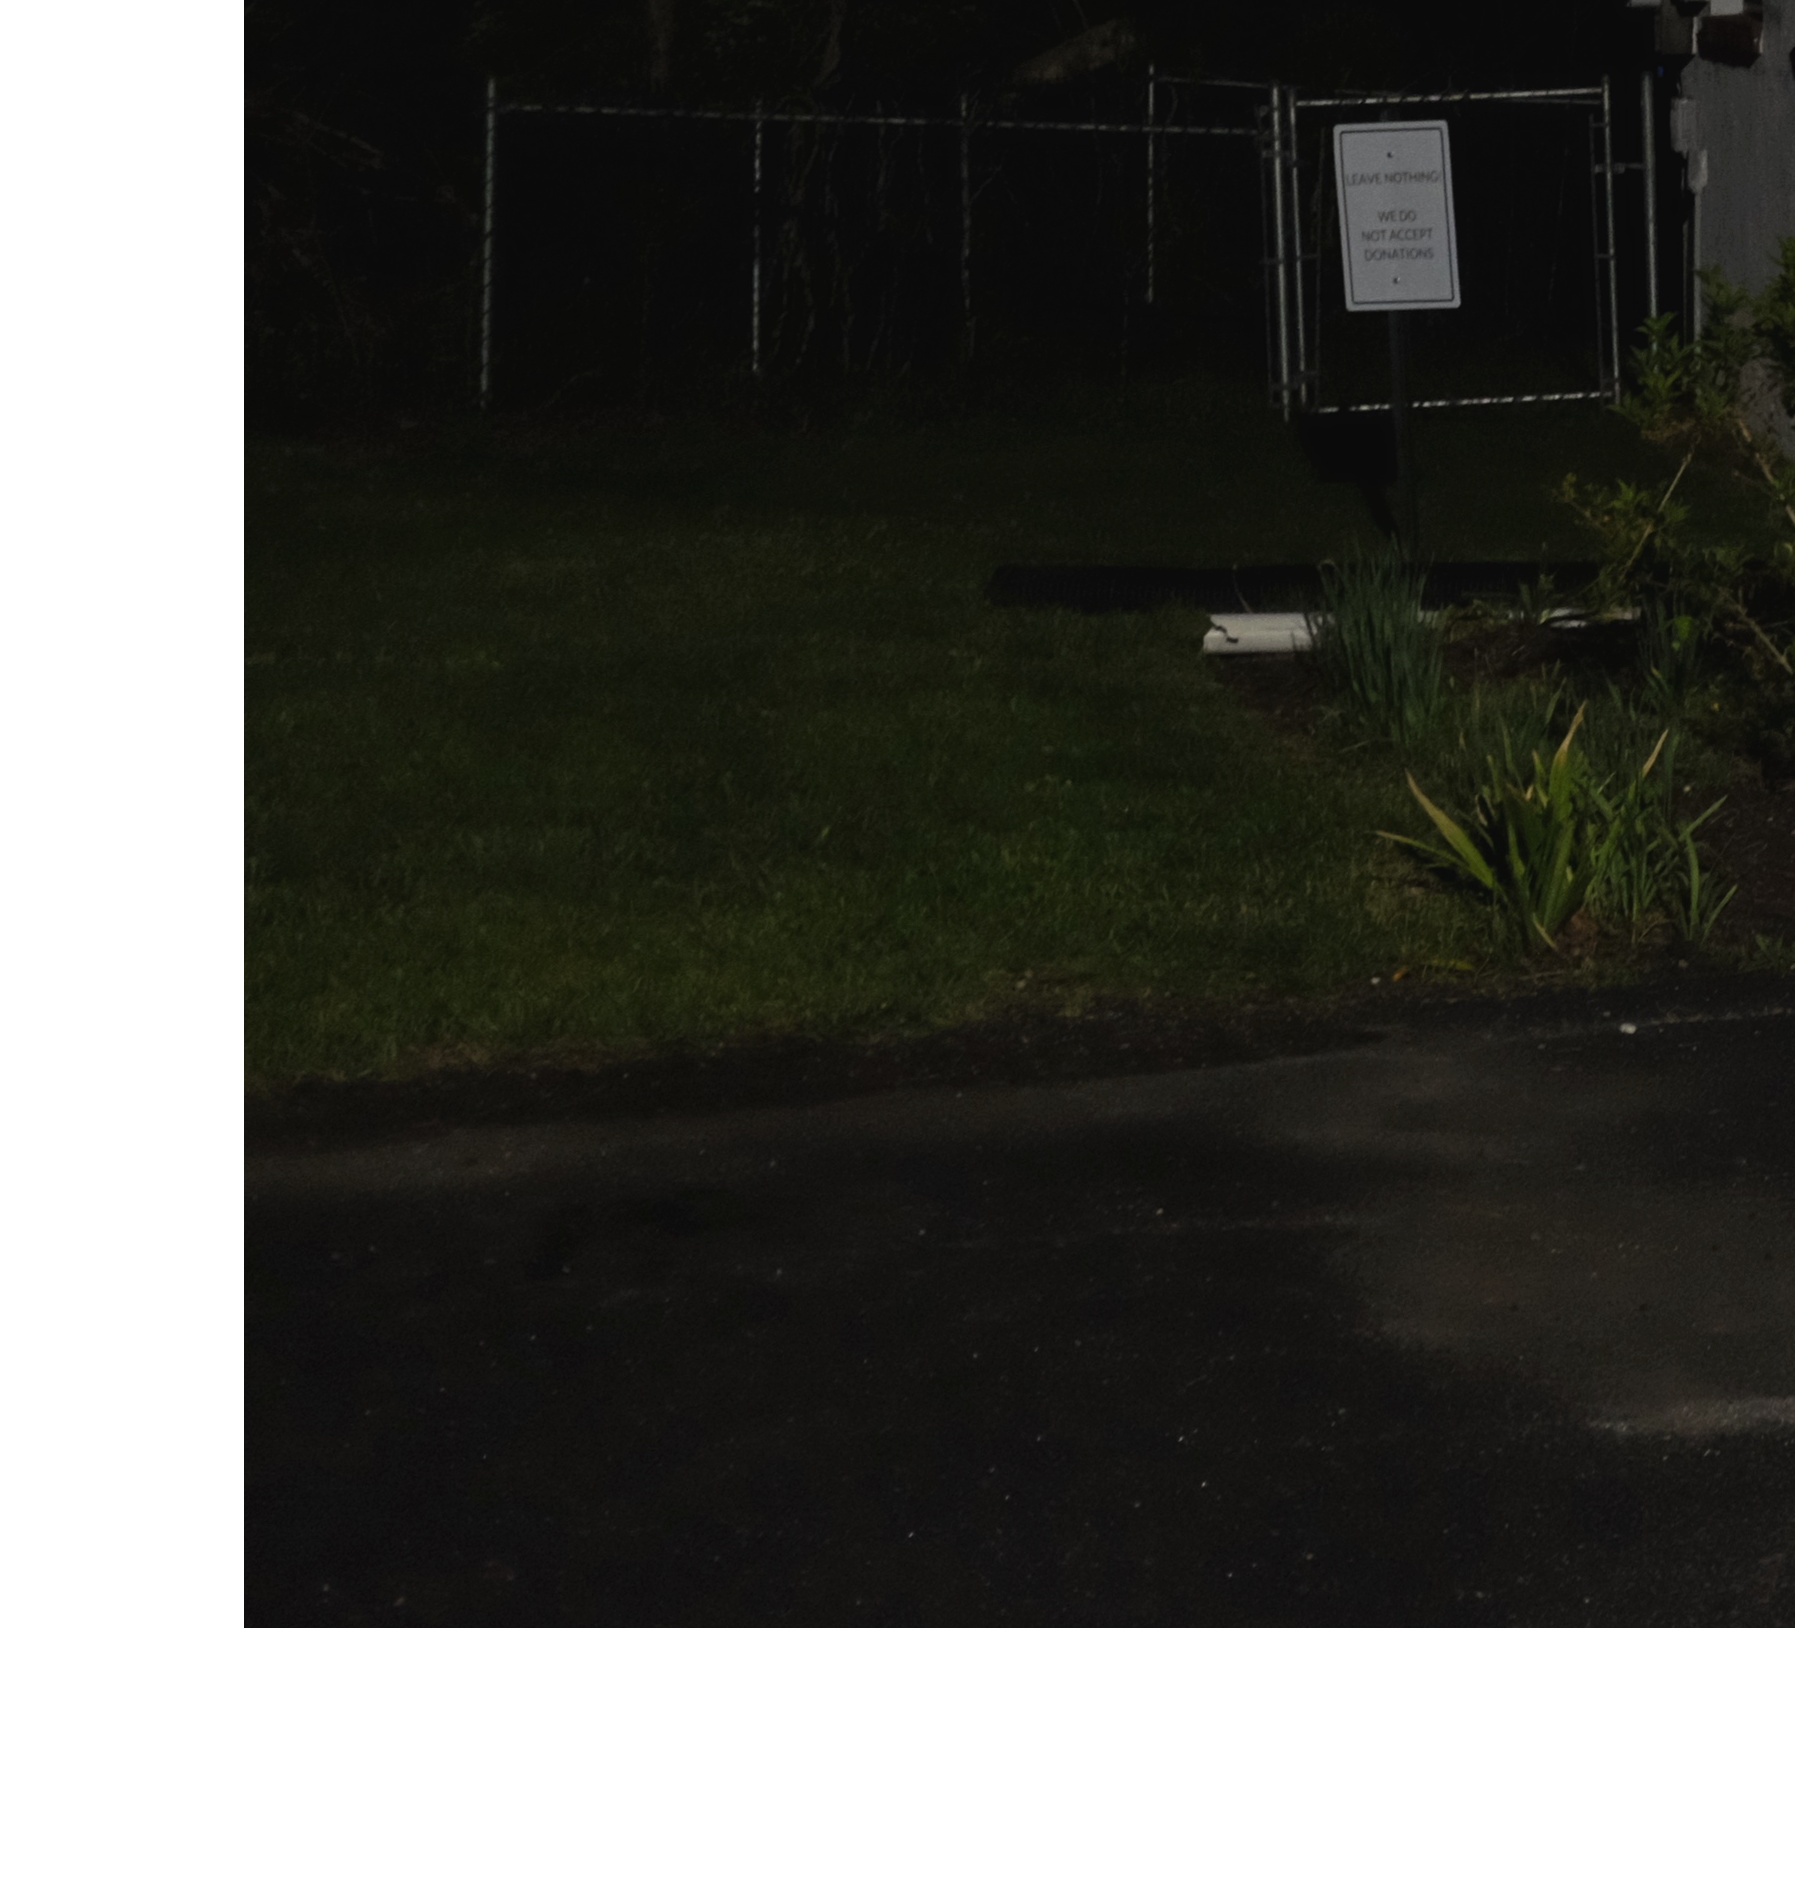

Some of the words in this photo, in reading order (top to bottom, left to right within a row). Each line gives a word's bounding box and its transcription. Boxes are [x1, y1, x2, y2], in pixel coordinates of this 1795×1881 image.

[1346, 173, 1381, 186] LEAVE
[1378, 210, 1397, 222] WE
[1400, 210, 1416, 222] DO
[1361, 229, 1387, 242] NOT
[1389, 227, 1433, 241] ACCEPT
[1364, 247, 1434, 261] DONATIONS
